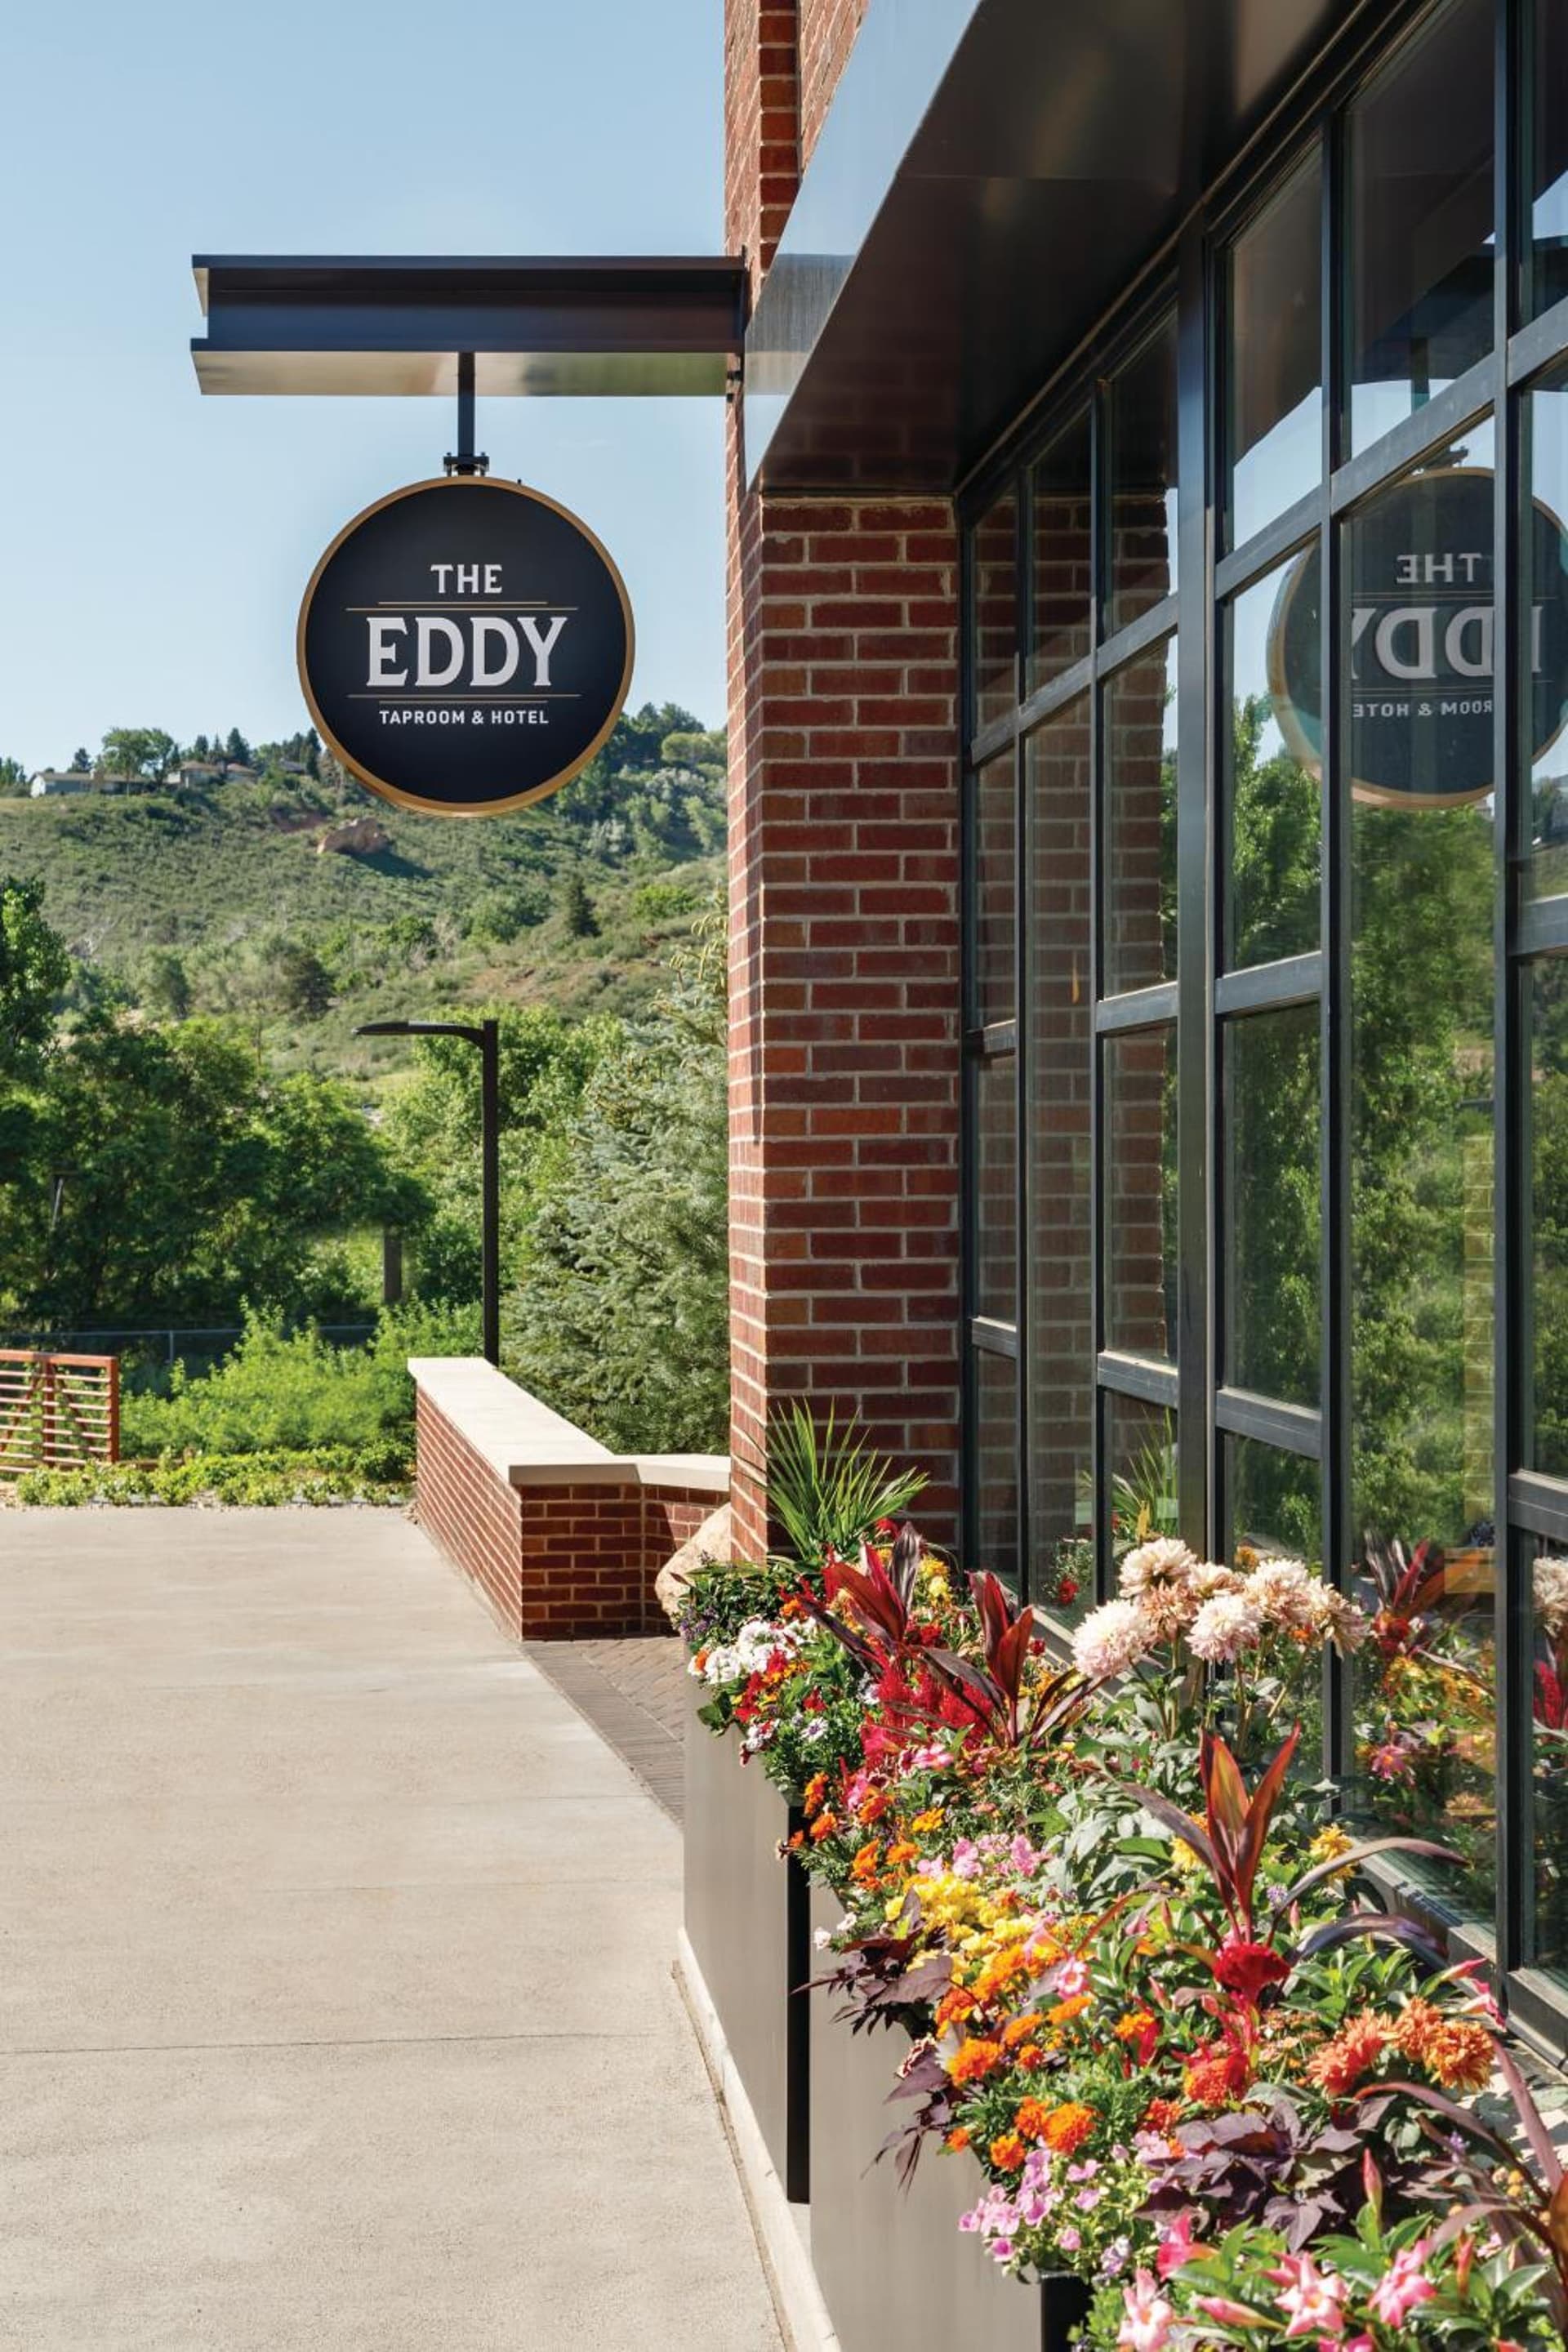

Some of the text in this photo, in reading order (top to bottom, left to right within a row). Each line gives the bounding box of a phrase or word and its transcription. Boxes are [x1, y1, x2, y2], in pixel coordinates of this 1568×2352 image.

[430, 564, 503, 594] THE
[366, 617, 568, 688] EDDY
[379, 710, 550, 725] TAPROOM & HOTEL
